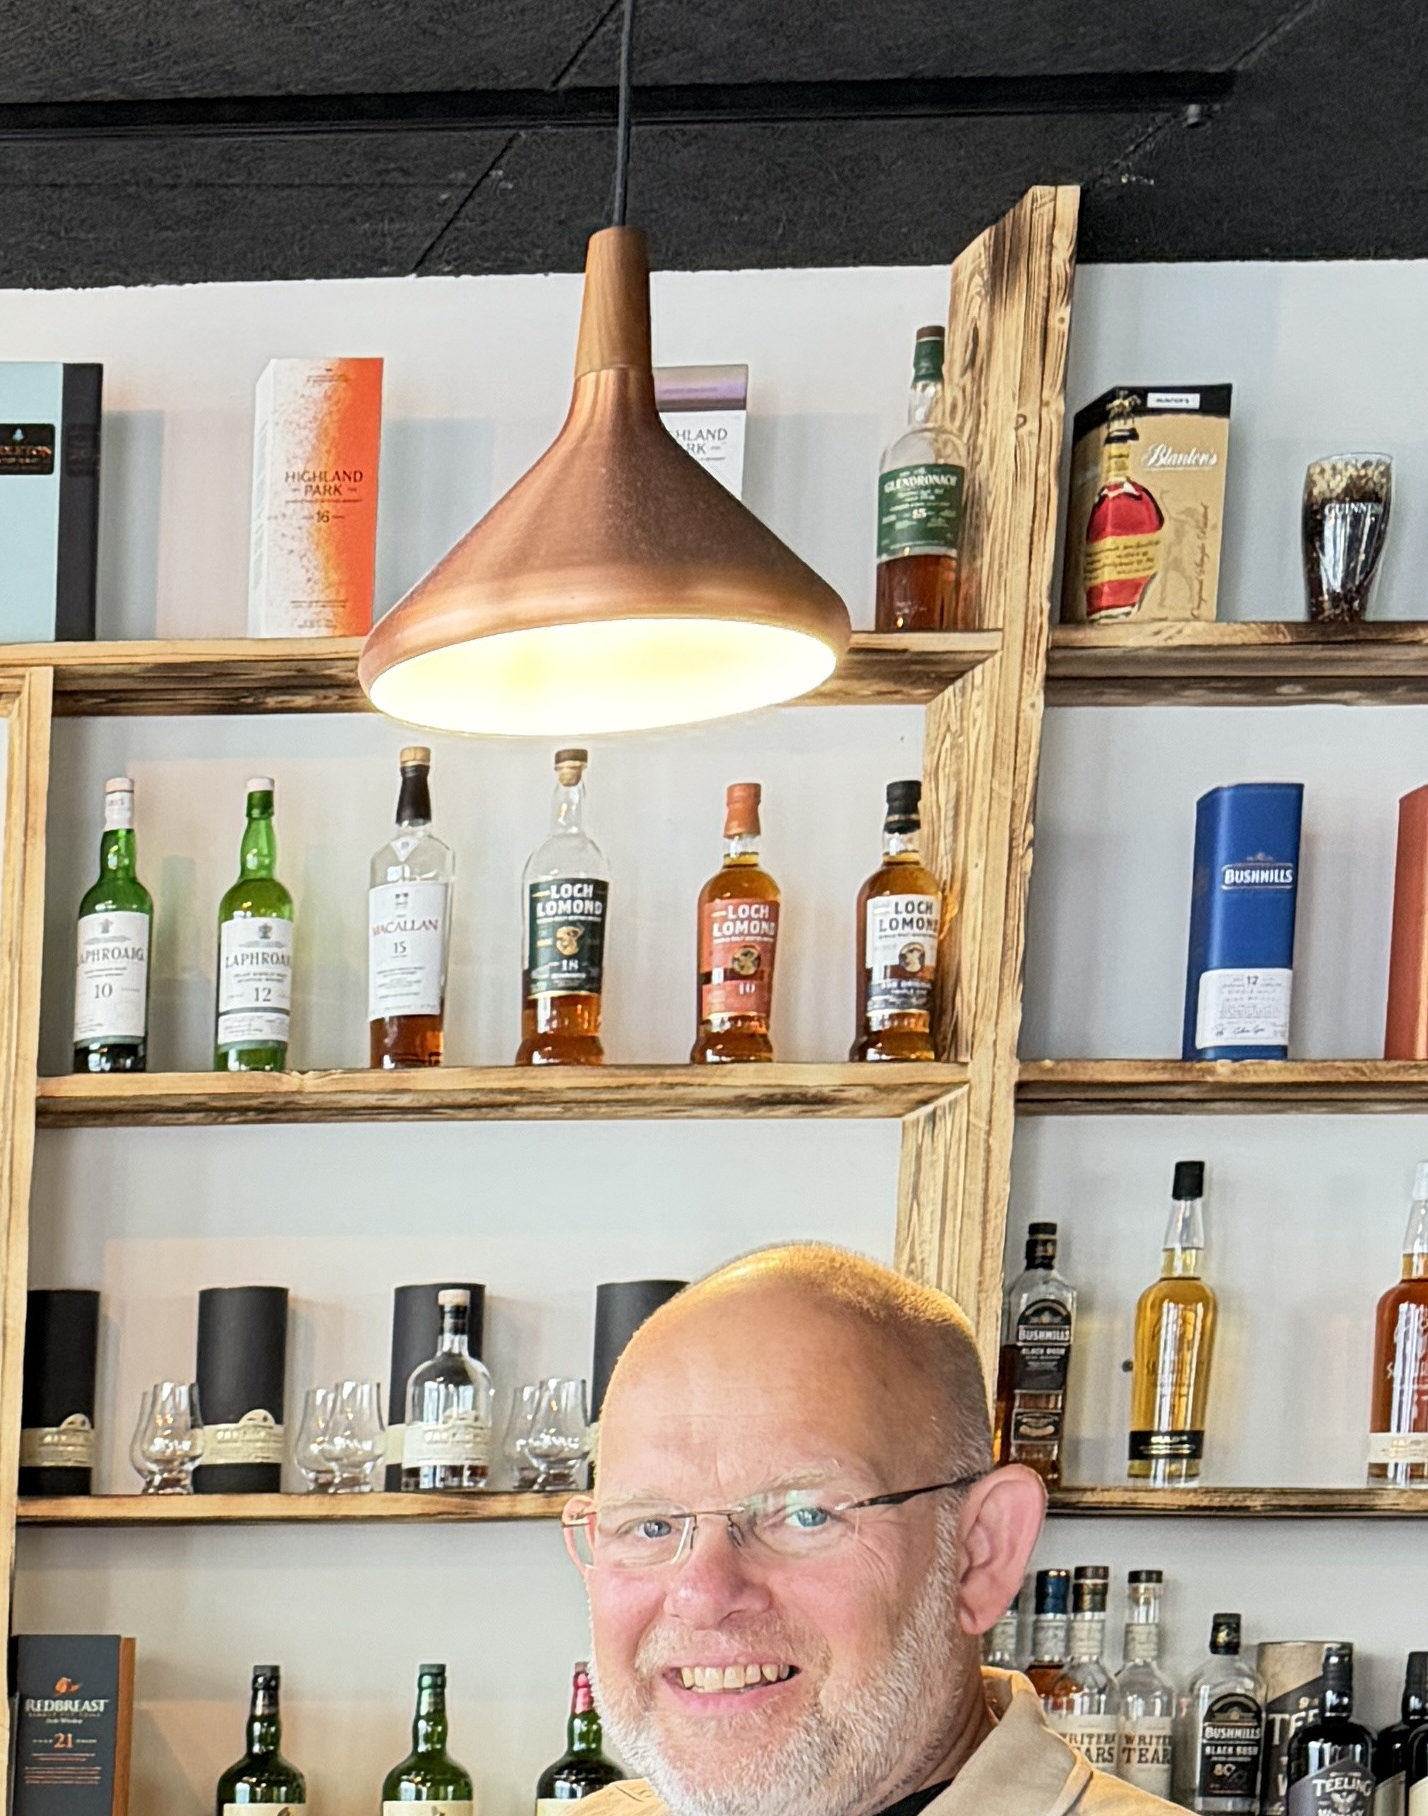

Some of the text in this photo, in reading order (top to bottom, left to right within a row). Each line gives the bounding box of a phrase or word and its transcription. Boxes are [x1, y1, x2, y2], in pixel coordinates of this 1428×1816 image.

[285, 469, 364, 484] HIGHLAND
[304, 484, 343, 497] PARK
[315, 510, 331, 524] 16
[550, 884, 594, 900] LOCH
[536, 899, 603, 916] LOMOND
[726, 903, 770, 920] LOCH
[894, 900, 934, 915] LOCH
[712, 920, 776, 937] LOMOND
[94, 984, 113, 999] 10
[254, 987, 272, 1002] 12
[53, 1732, 73, 1749] 21
[1204, 1726, 1261, 1740] BUSHMILLS
[1312, 1777, 1373, 1797] TEELING
